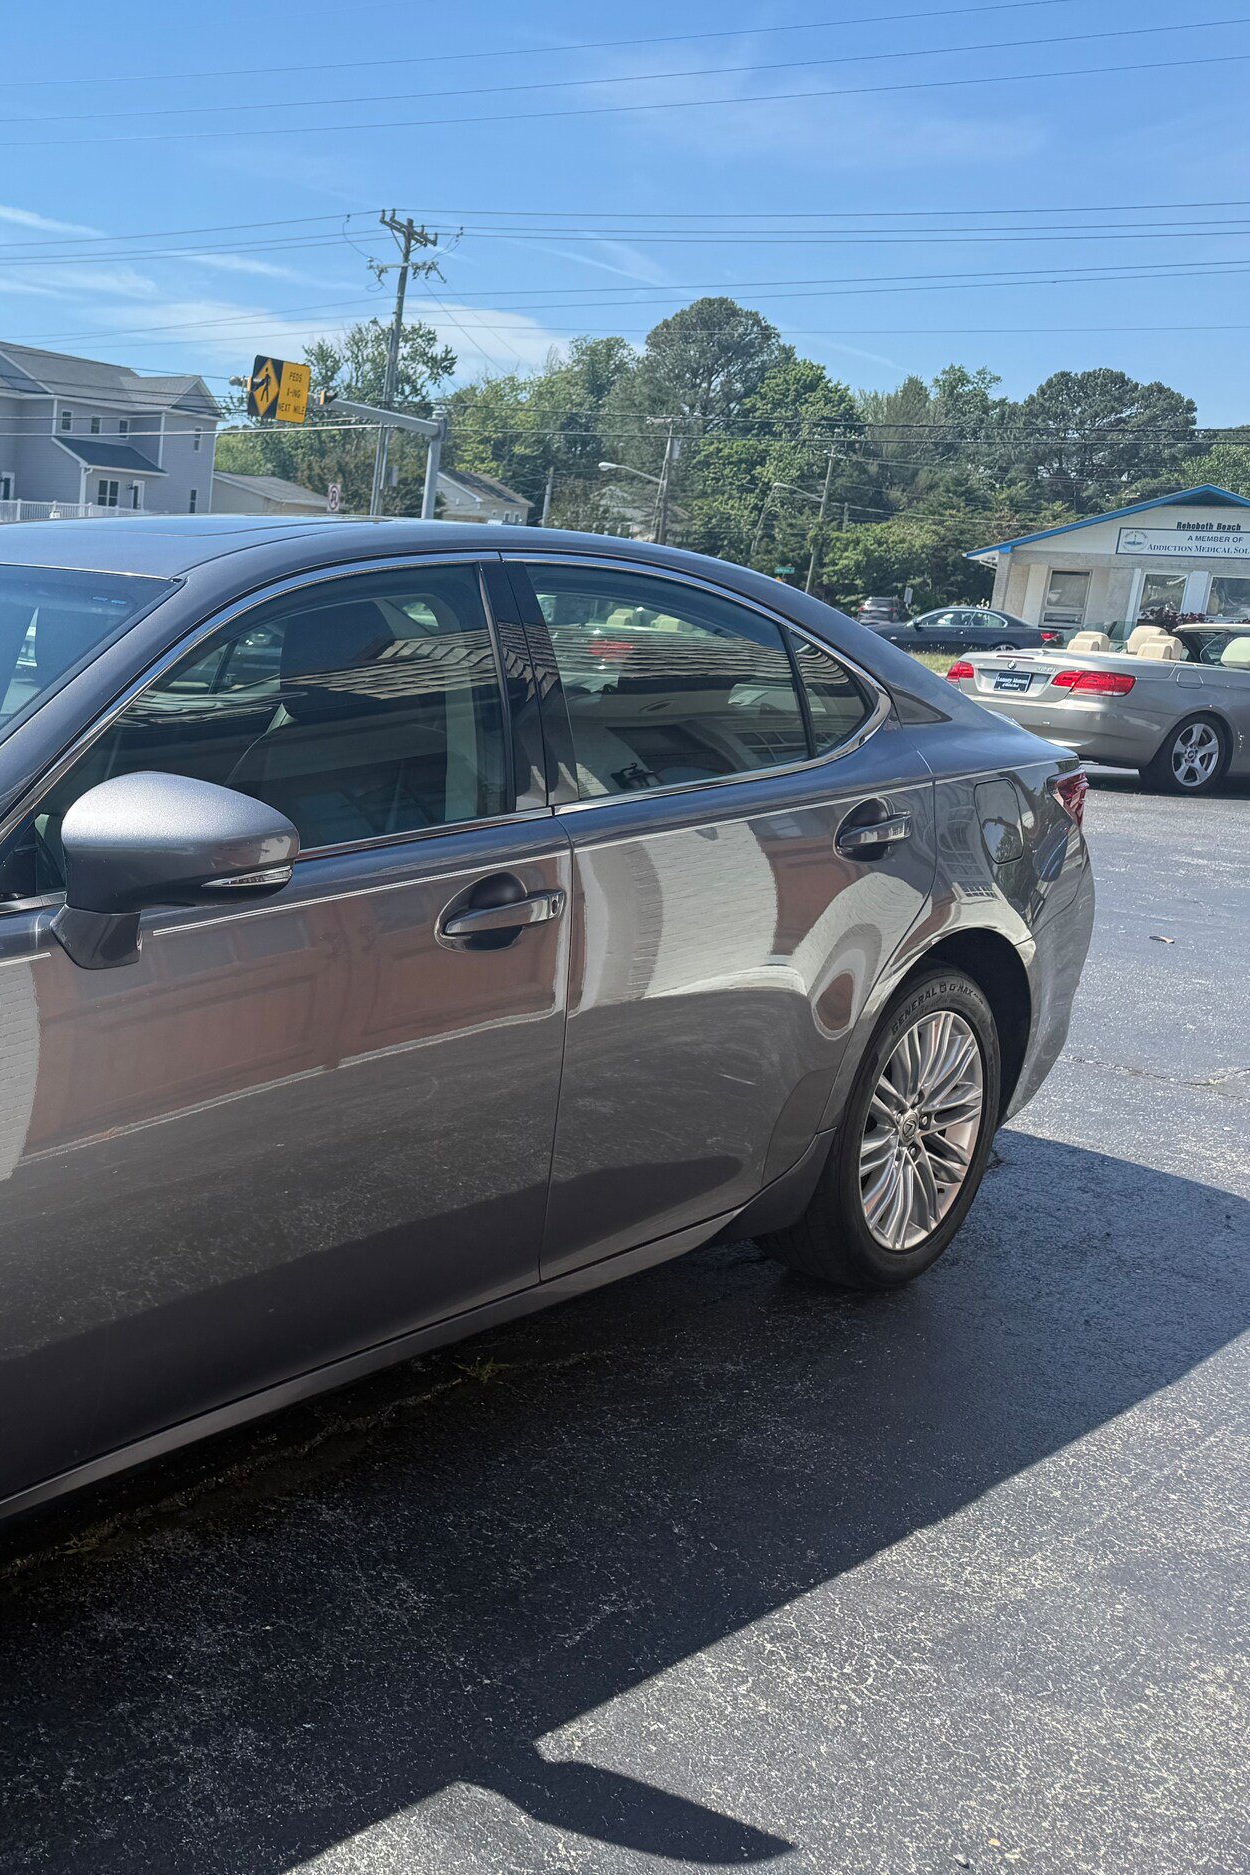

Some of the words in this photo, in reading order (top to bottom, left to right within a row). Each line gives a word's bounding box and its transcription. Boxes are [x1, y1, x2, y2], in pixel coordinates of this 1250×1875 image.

[288, 371, 303, 383] PEDS
[1176, 521, 1214, 531] Rehoboth
[1216, 522, 1242, 531] Beach
[1194, 535, 1230, 543] MEMBER
[891, 988, 938, 1034] GENERAL
